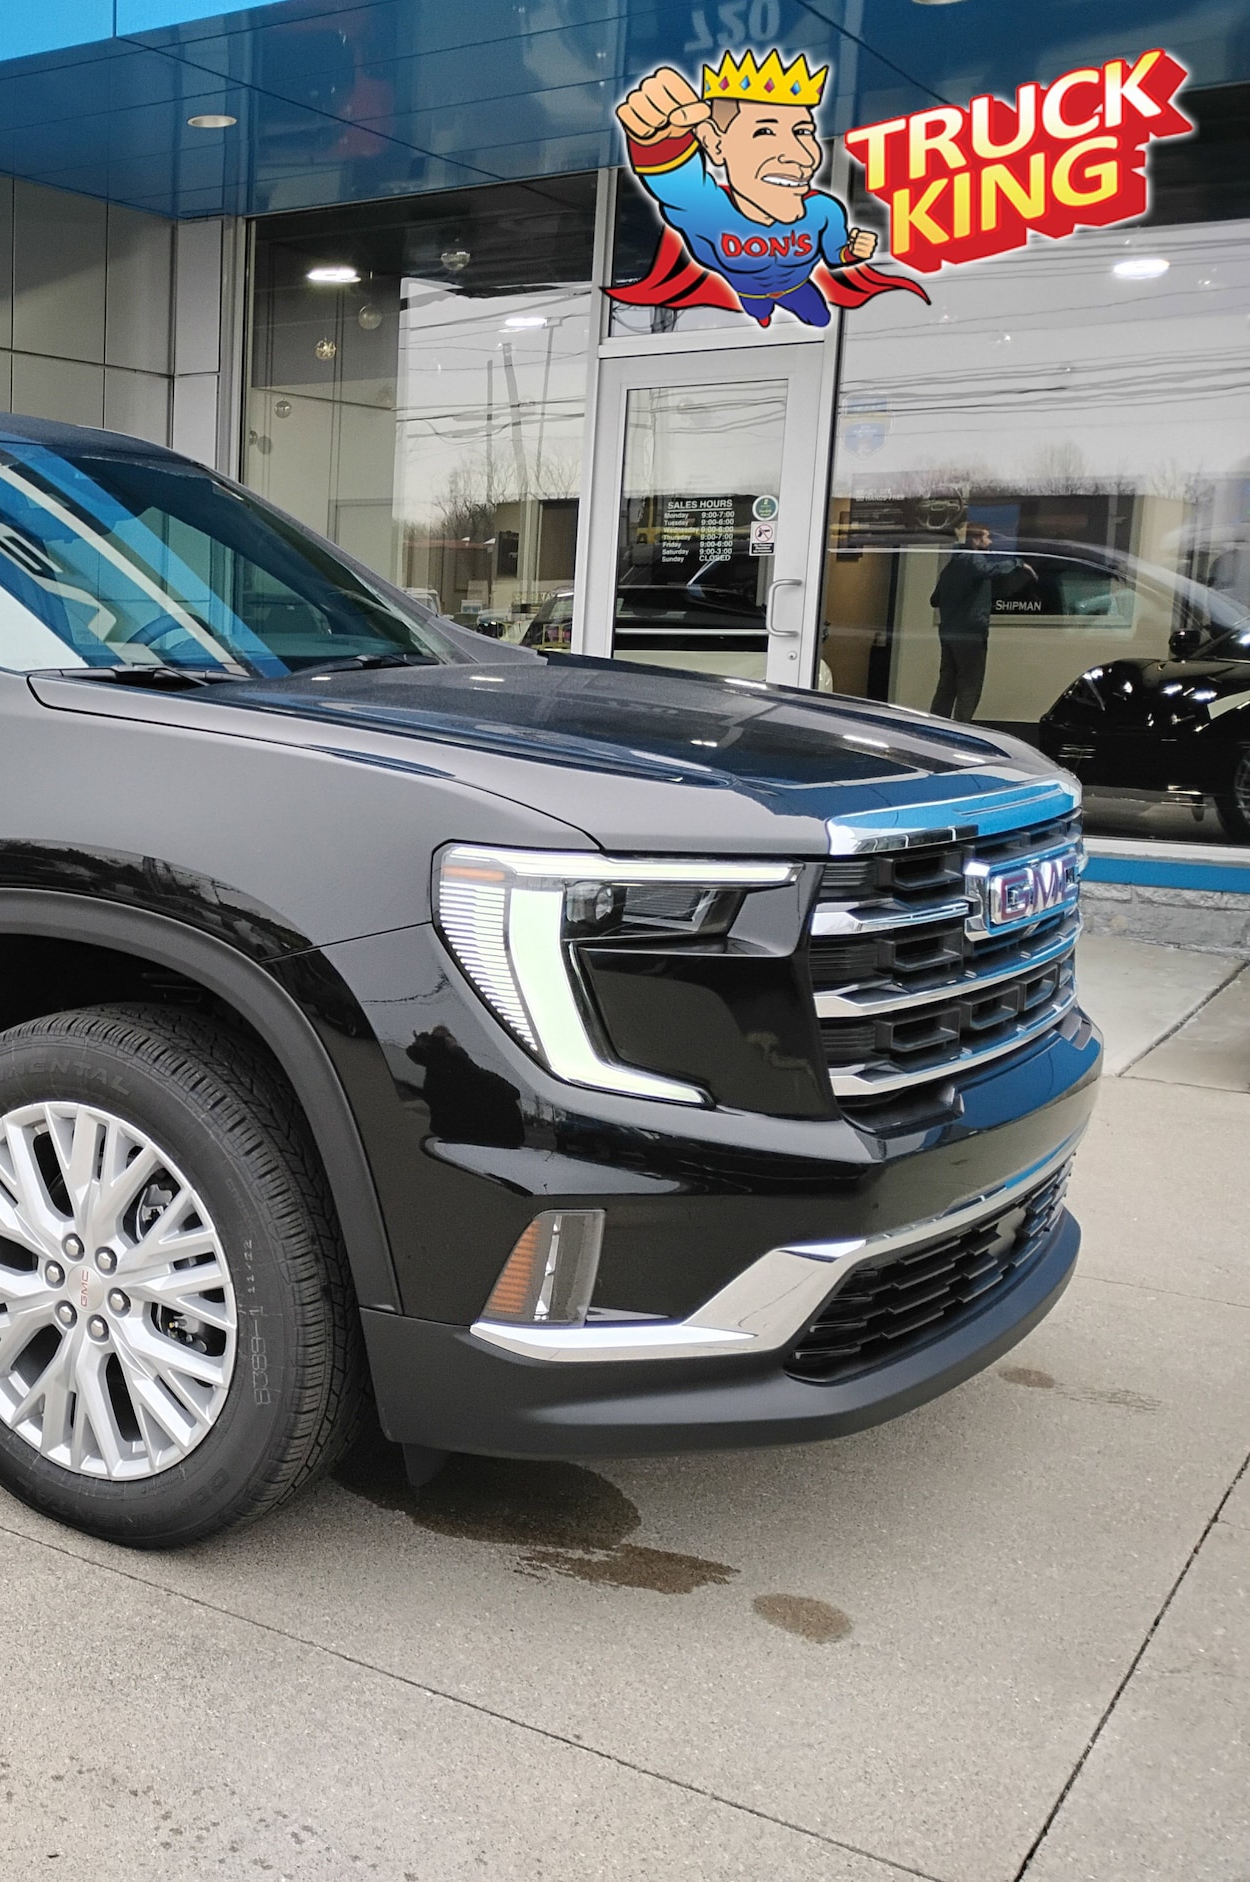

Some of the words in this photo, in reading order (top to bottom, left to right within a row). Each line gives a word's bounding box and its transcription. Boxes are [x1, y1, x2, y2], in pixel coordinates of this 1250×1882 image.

[667, 501, 698, 510] SALES
[699, 499, 733, 508] HOURS
[991, 852, 1078, 925] GMC
[80, 1270, 89, 1307] GMC
